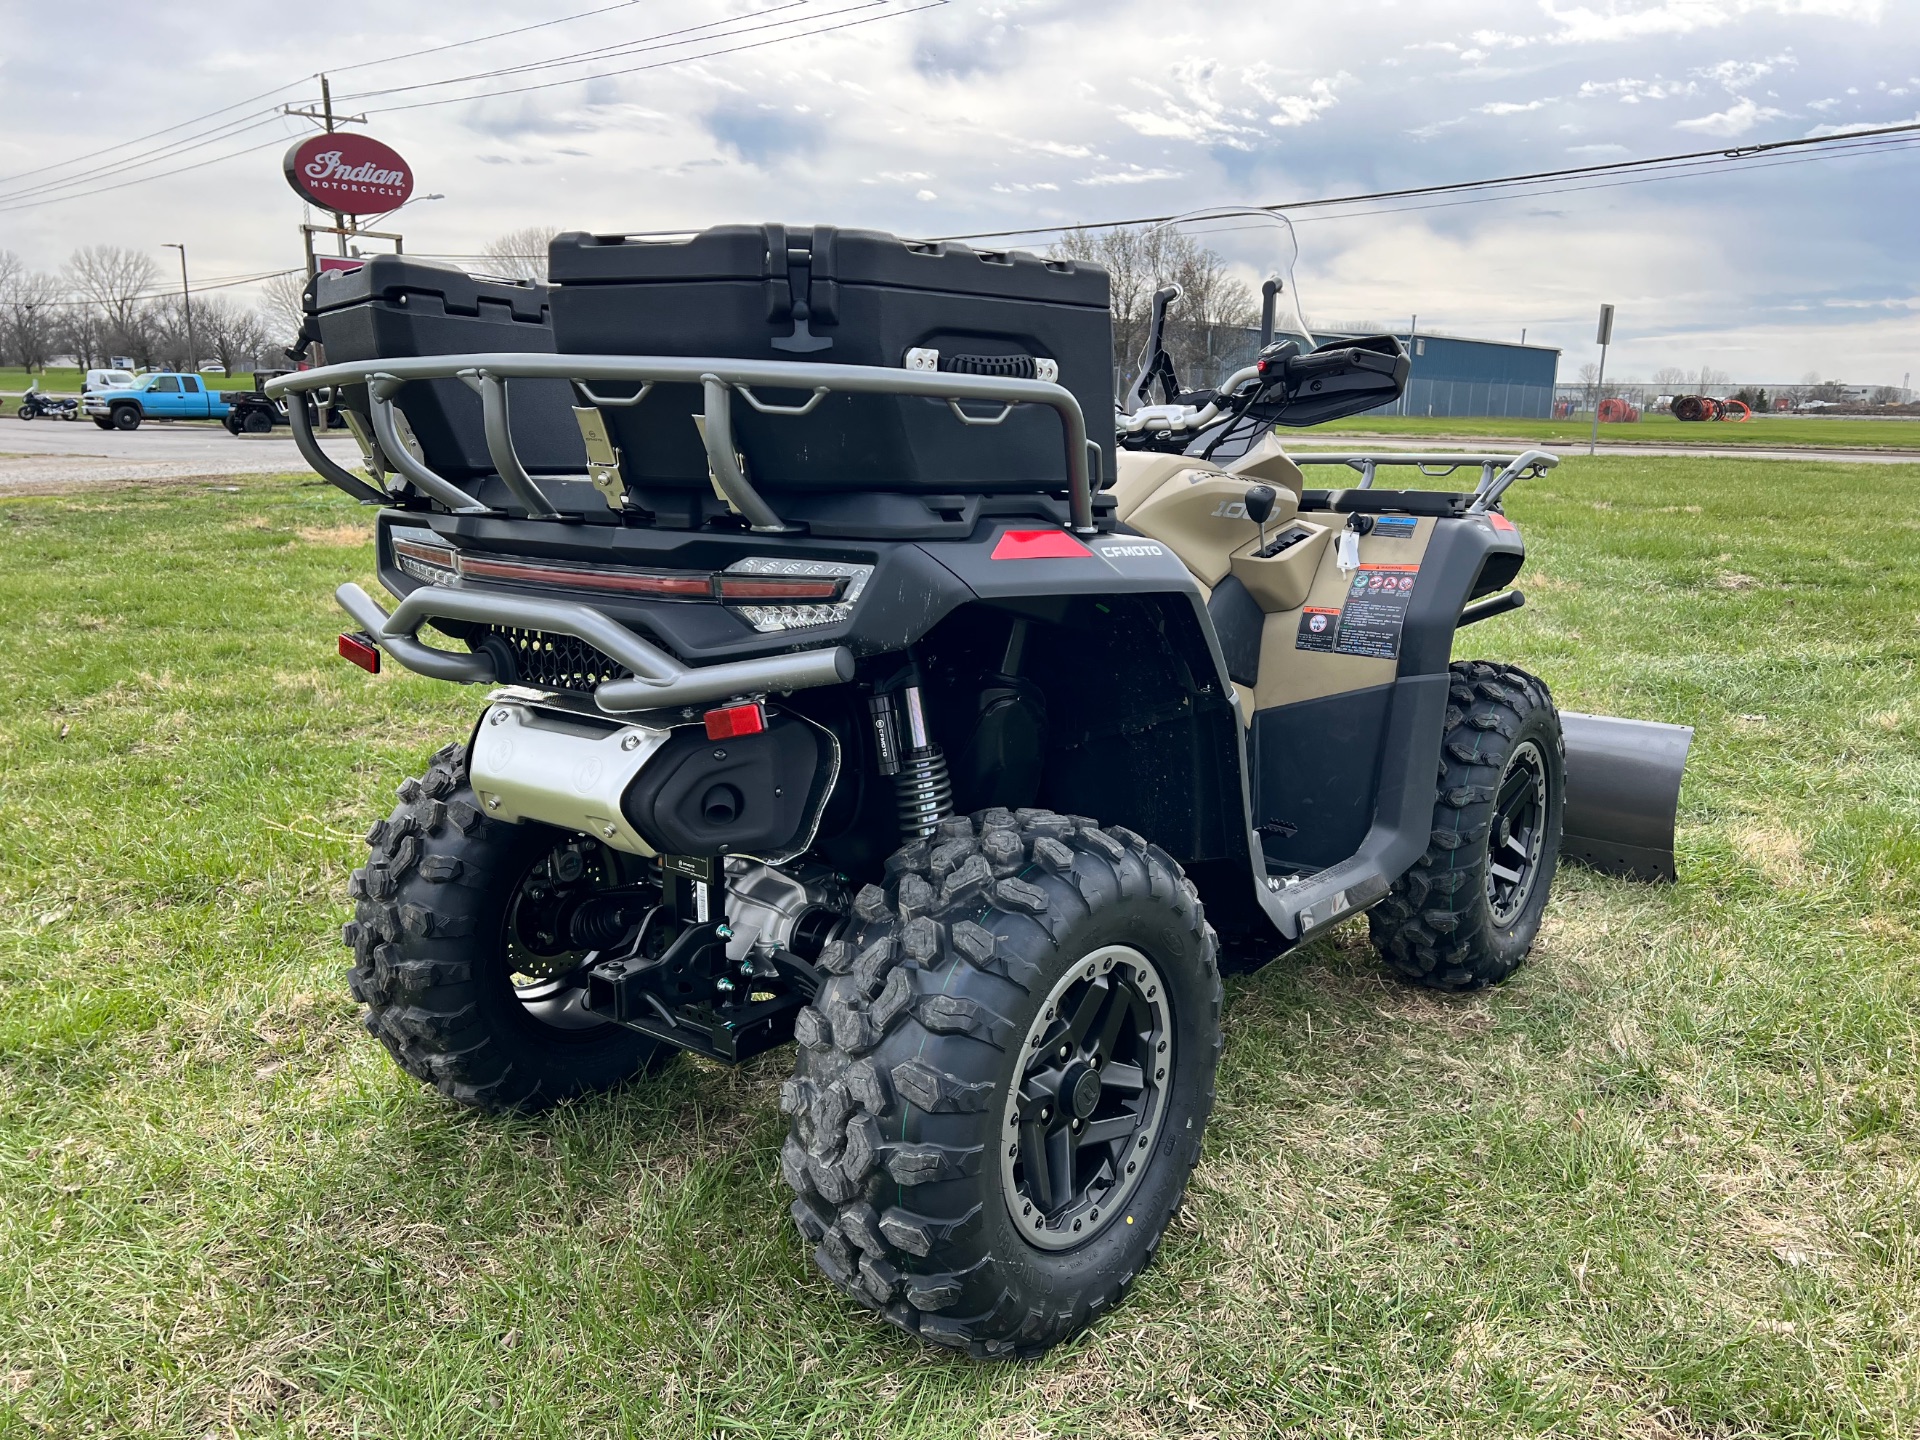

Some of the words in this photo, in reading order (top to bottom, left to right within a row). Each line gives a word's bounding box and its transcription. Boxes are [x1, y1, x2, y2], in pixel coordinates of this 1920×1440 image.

[305, 151, 404, 186] Indian
[310, 180, 402, 197] MOTORCYCLE
[1100, 545, 1163, 557] CFMOTO
[878, 729, 888, 757] CFMOTO
